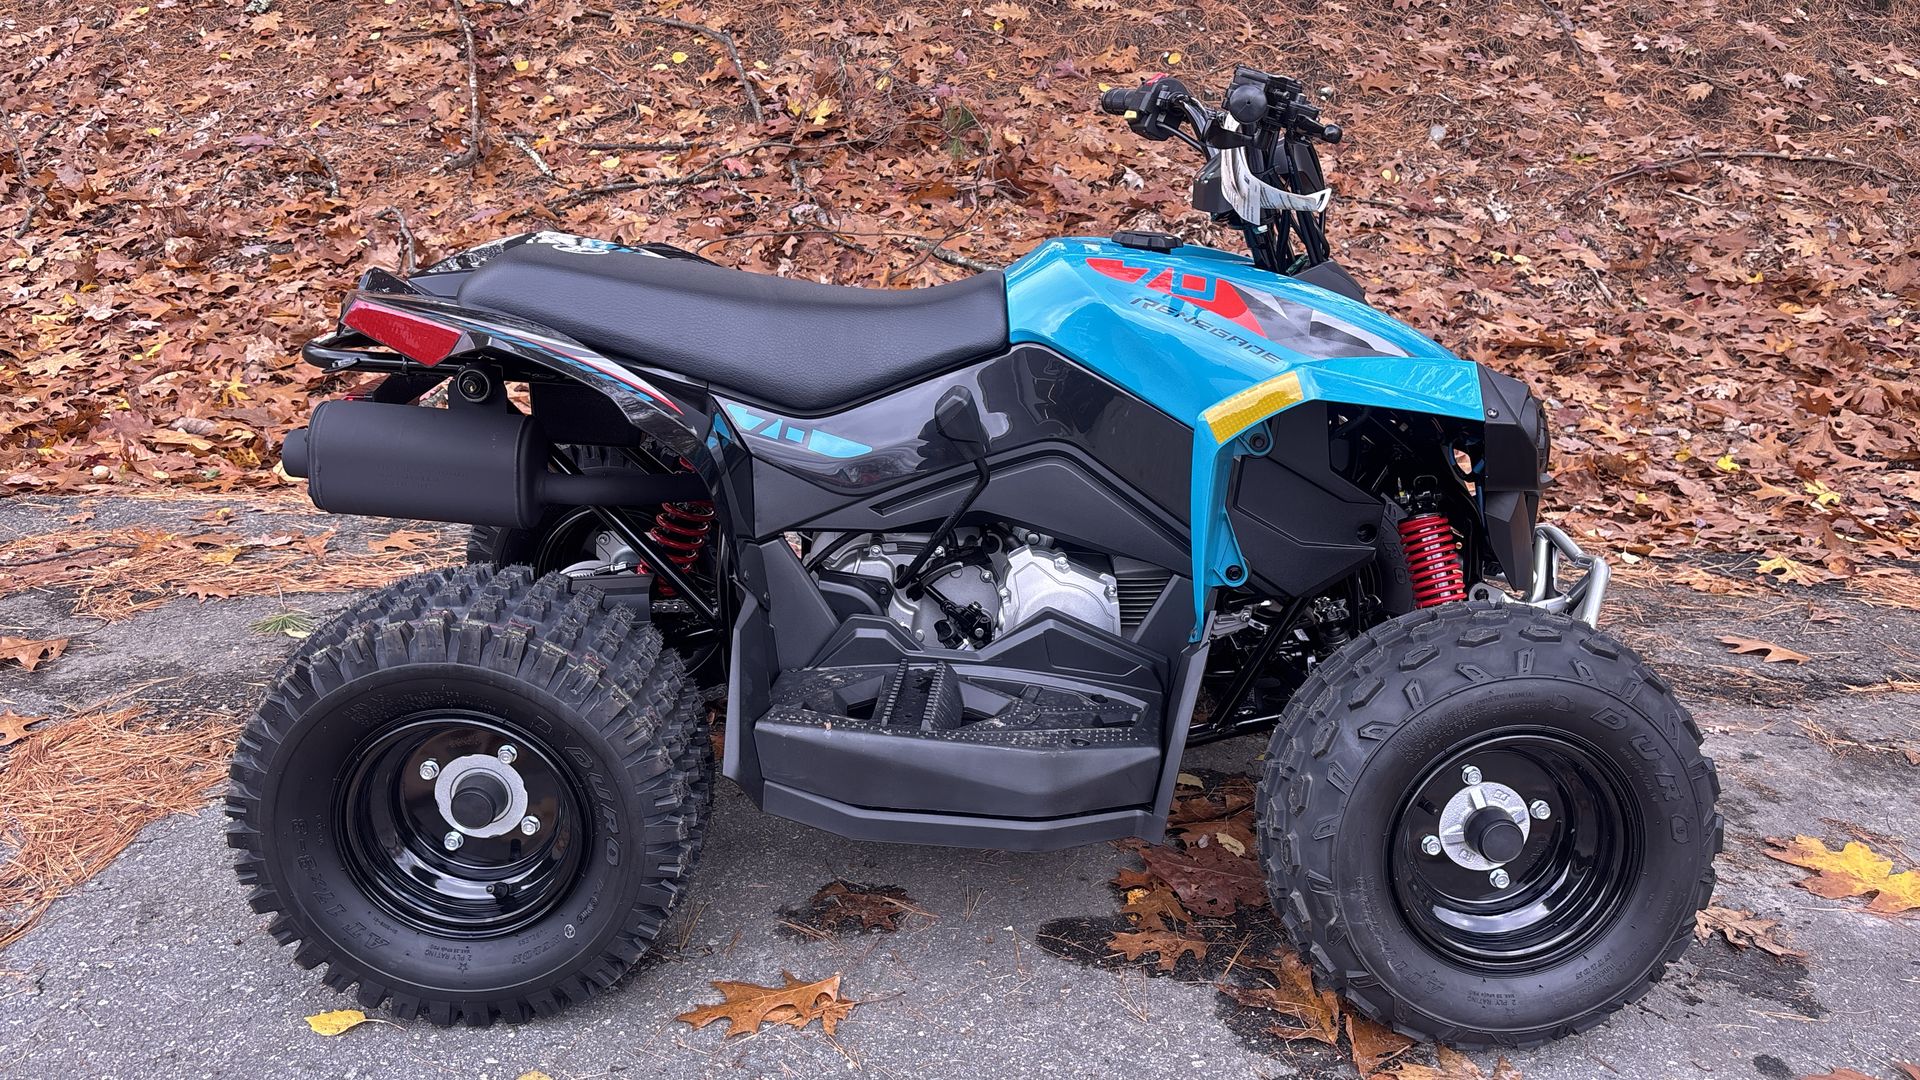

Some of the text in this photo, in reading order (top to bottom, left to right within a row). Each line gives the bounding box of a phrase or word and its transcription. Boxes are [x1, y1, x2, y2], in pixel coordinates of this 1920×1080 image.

[1122, 261, 1218, 302] 70
[1130, 297, 1284, 365] RENEGADE
[746, 408, 813, 449] 70
[1590, 706, 1690, 845] DURO
[564, 747, 621, 867] DURO
[424, 949, 473, 962] 2 PLY RATING
[1466, 995, 1492, 1006] RATING
